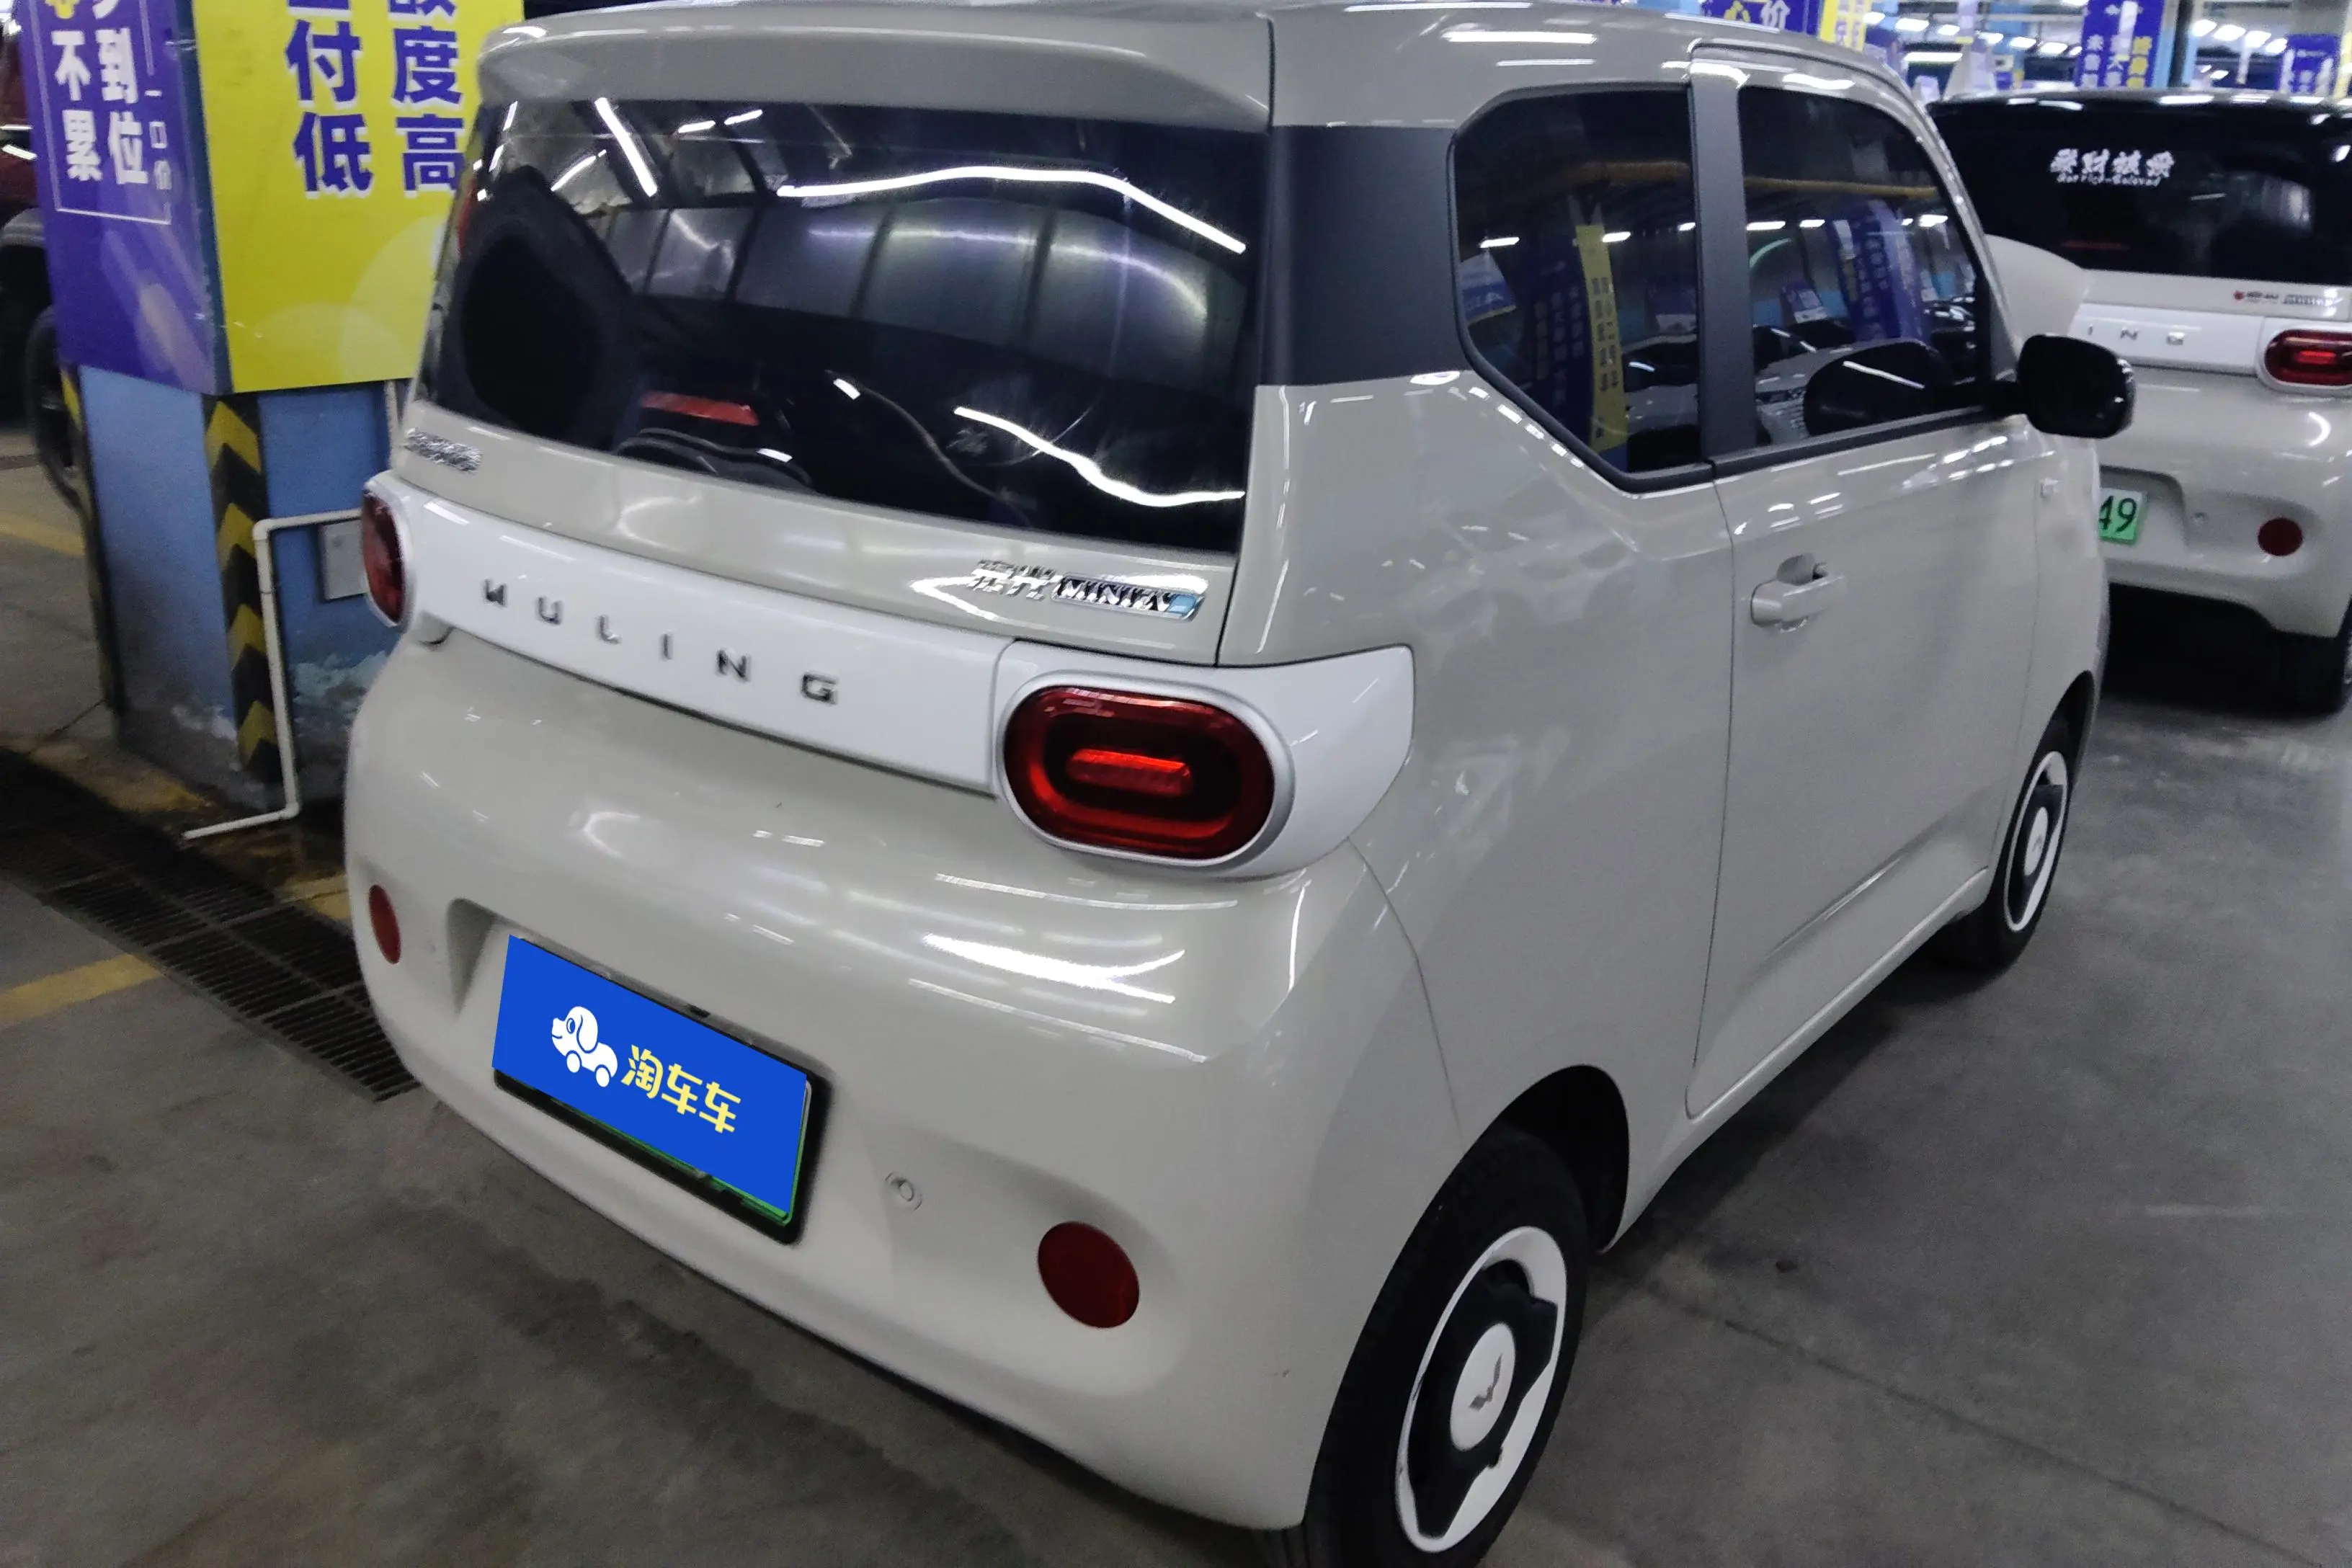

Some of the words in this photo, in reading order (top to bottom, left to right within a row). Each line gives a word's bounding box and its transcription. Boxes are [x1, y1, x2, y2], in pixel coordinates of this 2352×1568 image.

[92, 0, 149, 185] 到位
[285, 0, 375, 200] 付低
[2098, 495, 2137, 533] 49
[483, 579, 838, 706] WULING
